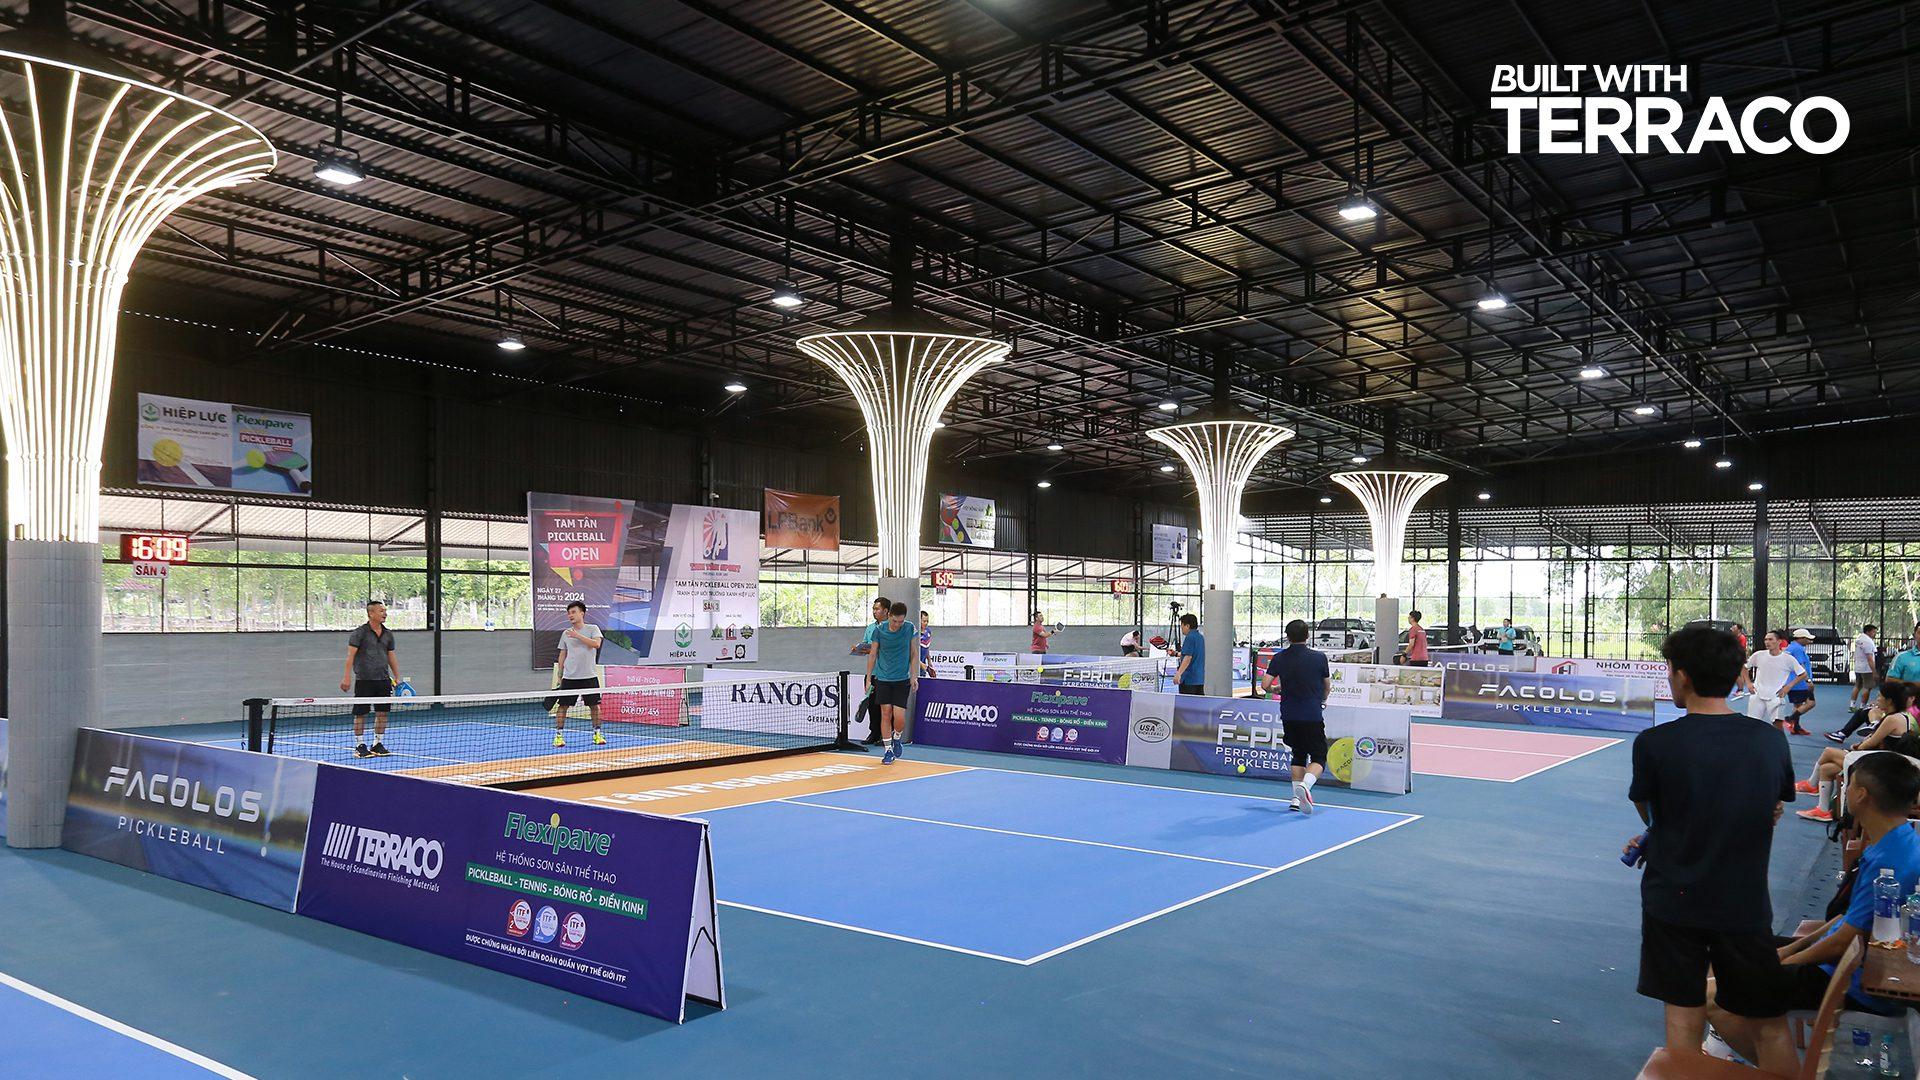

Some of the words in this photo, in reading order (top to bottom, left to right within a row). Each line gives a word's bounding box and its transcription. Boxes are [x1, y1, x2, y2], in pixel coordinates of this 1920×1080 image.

[163, 406, 196, 420] HIỆP
[236, 414, 294, 430] Flexipave
[241, 434, 292, 447] PICKLEBALL
[554, 518, 576, 528] TAM
[577, 516, 598, 528] TÂN
[547, 532, 606, 542] PICKLEBALL
[561, 547, 600, 561] OPEN
[135, 563, 157, 576] SÂN
[160, 566, 167, 576] 4
[700, 581, 729, 589] PICKLEBALL
[564, 592, 585, 601] 2024
[1063, 669, 1113, 683] F-PRO
[731, 682, 839, 708] RANGOS
[1031, 690, 1088, 707] Flexipave
[1478, 684, 1616, 703] FACOLOS
[945, 703, 998, 722] TERRACO
[1496, 703, 1593, 716] PICKLEBALL
[1219, 710, 1283, 724] FACOL
[1217, 724, 1293, 752] F-PR
[1216, 747, 1293, 762] PERFORMAN
[1224, 757, 1288, 771] PICKLEBA
[104, 766, 262, 823] FACOLOS
[118, 815, 224, 855] PICKLEBALL
[504, 812, 611, 855] Flexipave
[355, 827, 443, 879] TERRACO
[495, 850, 506, 863] HỆ
[508, 852, 535, 868] THỐNG
[536, 859, 554, 871] SƠN
[555, 862, 572, 875] SÂN
[575, 865, 591, 879] THỂ
[593, 870, 617, 884] THAO
[321, 857, 330, 866] The
[330, 859, 346, 870] House
[346, 863, 352, 873] of
[353, 865, 387, 880] Scandinavian
[387, 872, 411, 888] Finishing
[413, 879, 440, 892] Materials
[468, 867, 513, 886] PICKLEBALL
[519, 878, 548, 893] TENNIS
[553, 884, 577, 900] BÓNG
[579, 887, 593, 902] RỔ
[621, 900, 644, 915] KINH
[516, 908, 526, 917] ITF
[509, 920, 514, 929] 2
[535, 926, 540, 935] 3
[570, 920, 580, 929] ITF
[562, 933, 567, 942] 4
[465, 934, 481, 944] ĐƯỢC
[481, 938, 500, 949] CHỨNG
[500, 943, 517, 954] NHẬN
[576, 963, 588, 973] VỢT
[590, 966, 602, 976] THẾ
[602, 970, 615, 980] GIỚI
[616, 975, 627, 983] ITF
